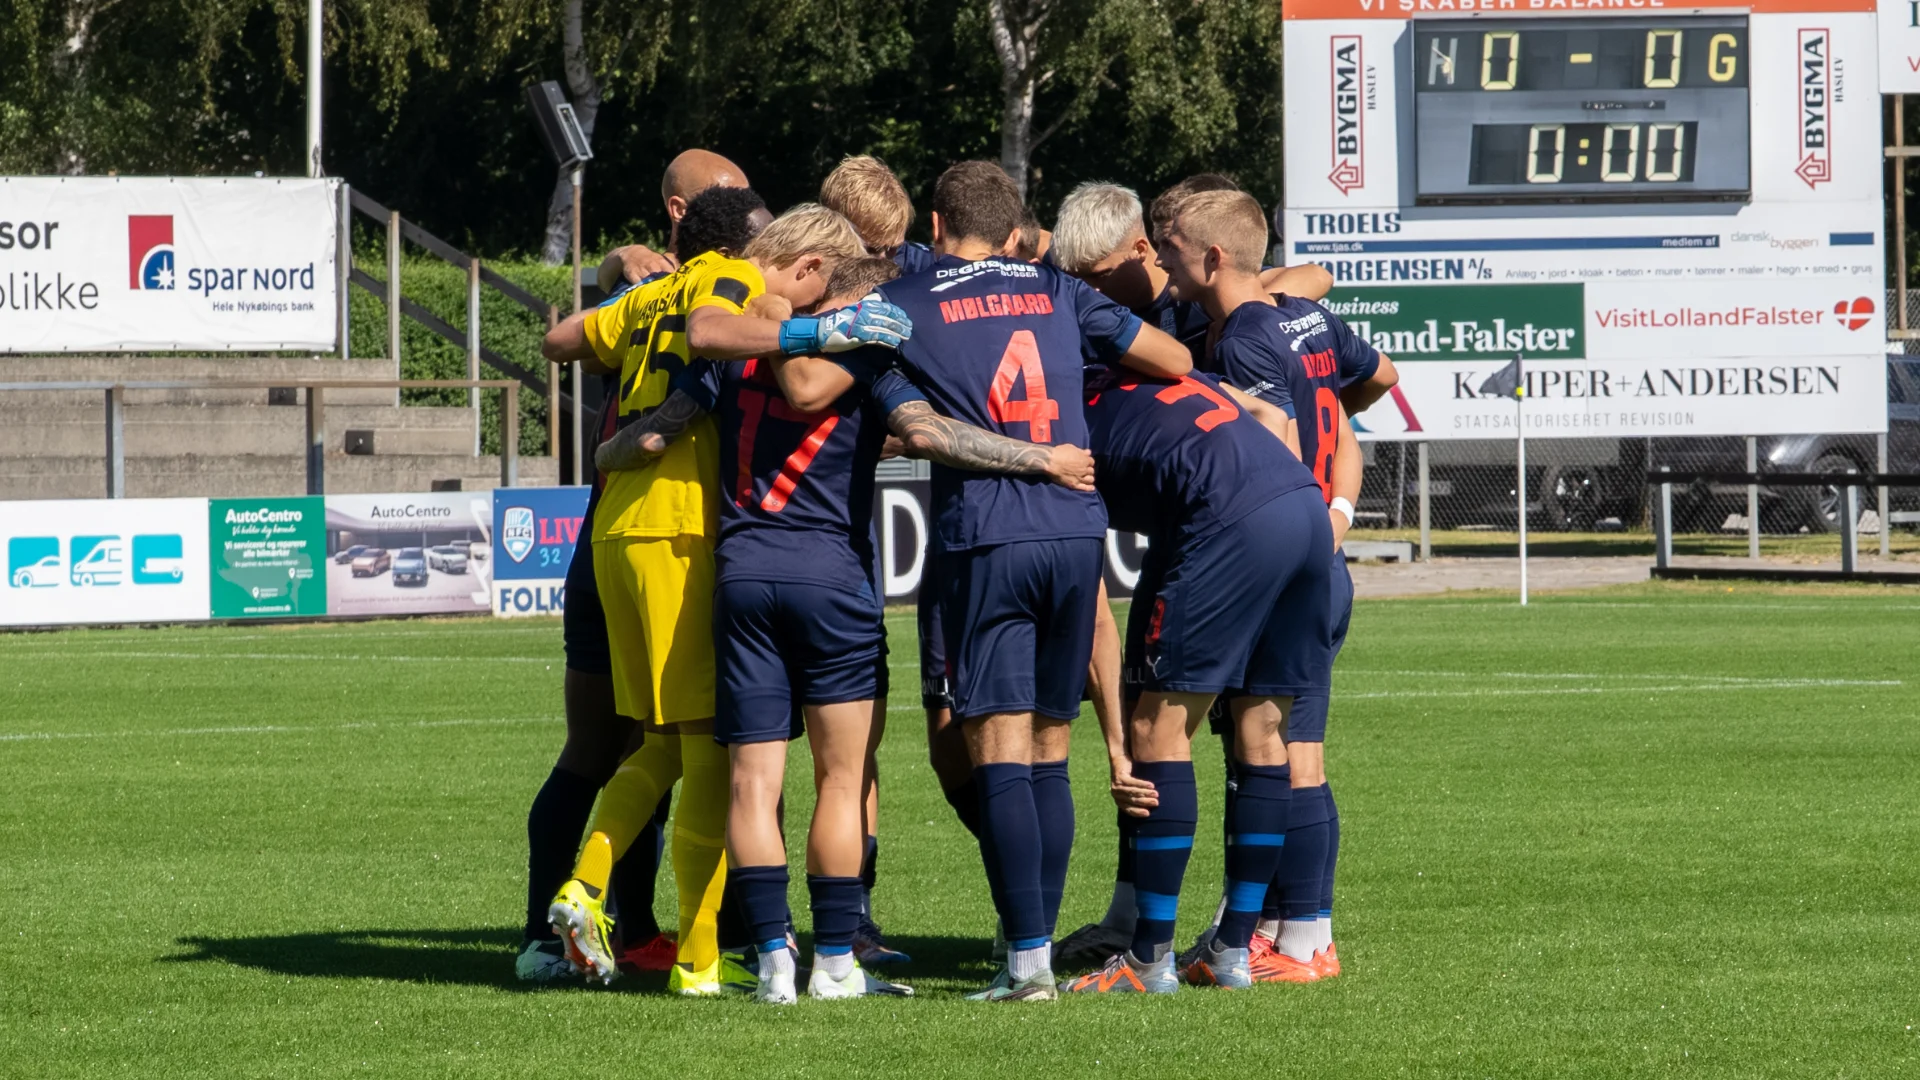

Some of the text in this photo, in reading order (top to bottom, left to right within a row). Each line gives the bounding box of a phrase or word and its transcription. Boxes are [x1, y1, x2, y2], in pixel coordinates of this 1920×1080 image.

[1481, 31, 1519, 90] 0
[1644, 30, 1683, 88] 0
[1708, 34, 1737, 82] G
[1367, 65, 1376, 110] HASLEV
[1804, 36, 1825, 148] BYGMA
[1834, 57, 1843, 102] HASLEV
[1337, 43, 1357, 155] BYGMA
[1526, 123, 1684, 183] 0:00
[1304, 212, 1400, 235] TROELS
[1731, 231, 1769, 242] dansk
[1307, 242, 1364, 254] www.tjas.dk
[1662, 236, 1716, 247] medlem af
[1505, 269, 1536, 279] Anlæg
[1548, 267, 1568, 280] jord
[1578, 267, 1604, 277] kloak
[1616, 267, 1644, 276] beton
[1738, 265, 1765, 275] maler
[1777, 264, 1801, 276] hegn
[1812, 264, 1840, 274] smed
[1851, 265, 1873, 274] grus
[213, 301, 314, 313] Hele Nykøbings bank
[939, 293, 1054, 324] MØLGAARD
[1595, 306, 1825, 328] VisitLollandFalster
[987, 330, 1059, 443] 4
[1452, 366, 1841, 399] KMPER+ANDERSEN
[1620, 411, 1694, 426] REVISION
[735, 388, 840, 512] 17
[1313, 387, 1339, 503] 8
[225, 508, 304, 524] AutoCentro
[371, 504, 451, 518] AutoCentro
[500, 586, 564, 612] FOLK
